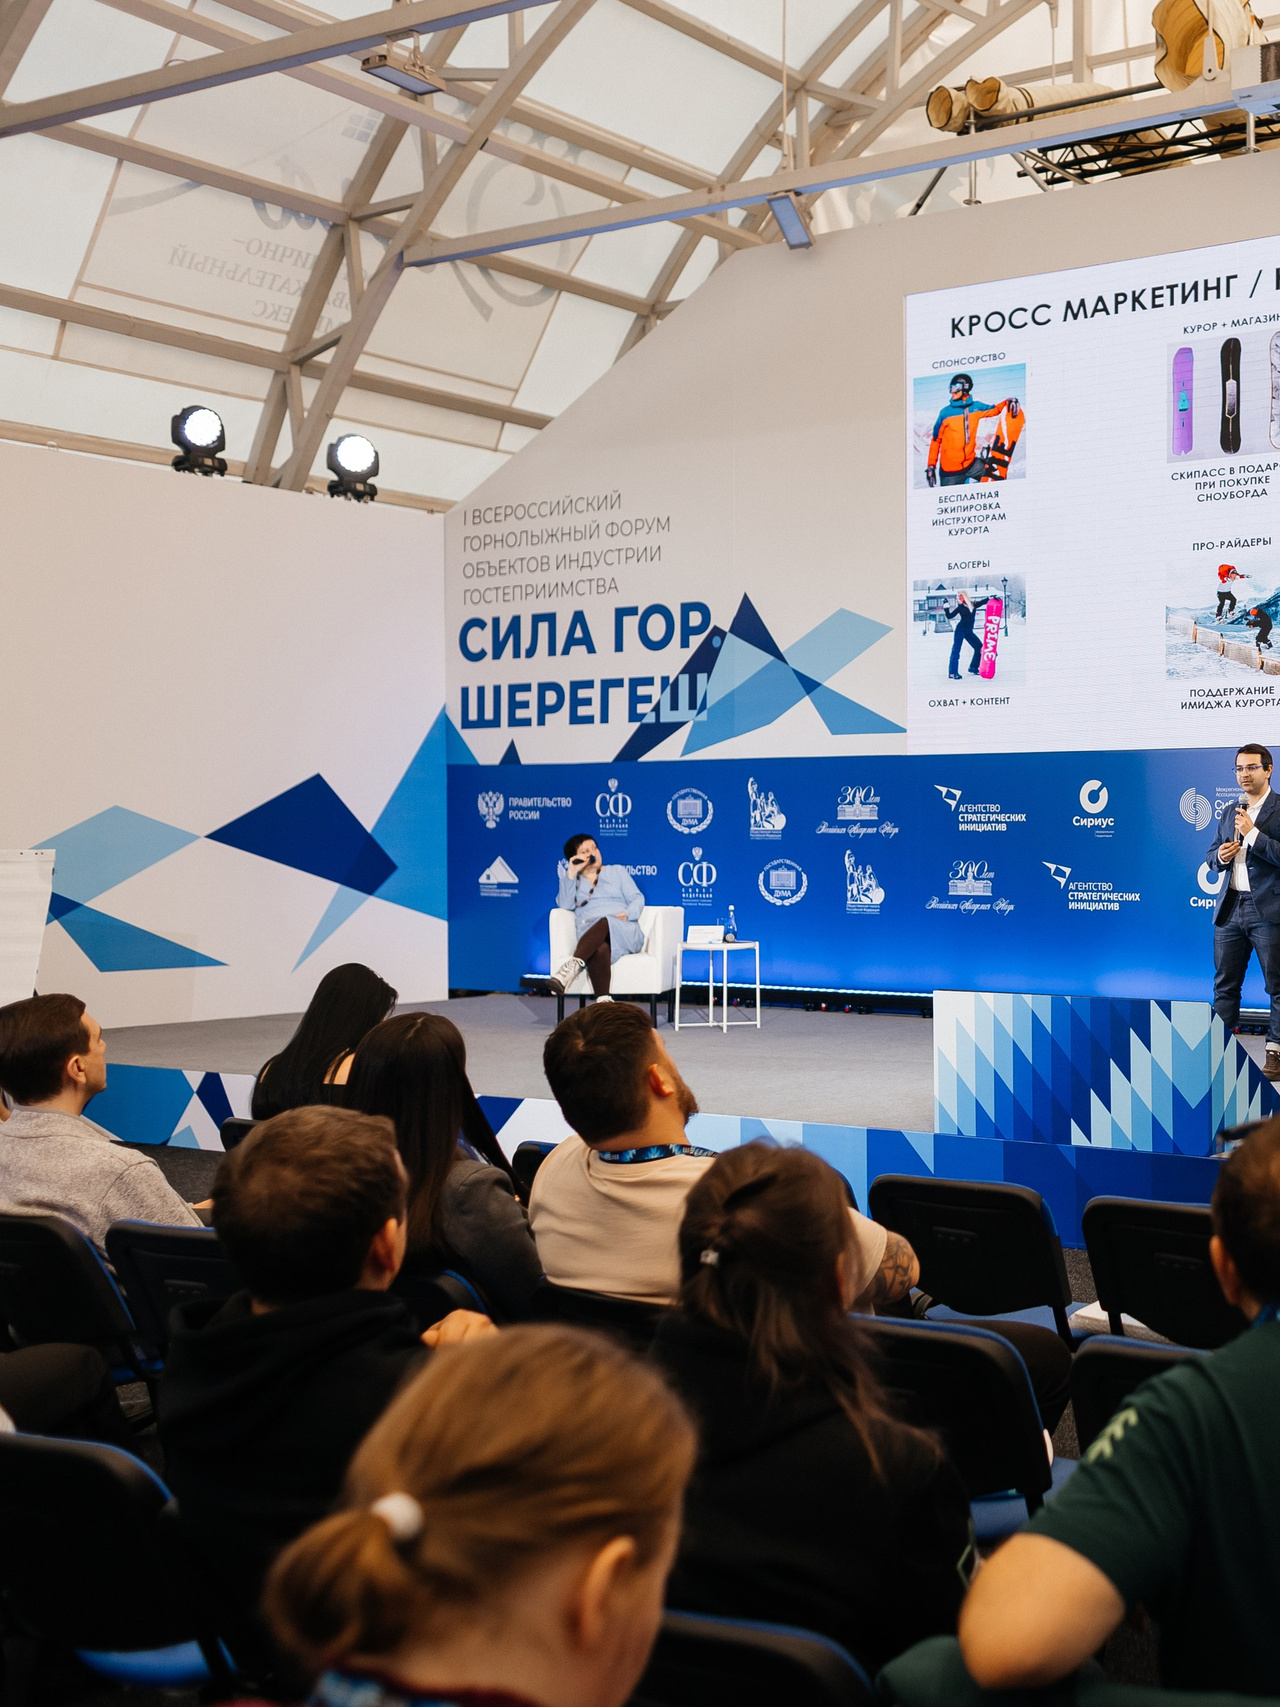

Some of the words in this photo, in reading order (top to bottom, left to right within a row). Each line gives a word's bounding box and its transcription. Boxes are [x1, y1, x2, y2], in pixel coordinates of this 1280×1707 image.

[951, 304, 1051, 338] КРОСС
[1062, 274, 1238, 322] МАРКЕТИНГ
[1249, 269, 1263, 298] /
[1183, 322, 1217, 334] КУРОР
[932, 352, 1006, 369] СПОНСОРСТВО
[1171, 467, 1226, 481] СКИПАСС
[1230, 467, 1235, 475] В
[1195, 481, 1216, 490] ПРИ
[1219, 475, 1270, 488] ПОКУПКЕ
[938, 491, 999, 504] БЕСПЛАТНАЯ
[1197, 488, 1268, 502] СНОУБОРДА
[471, 489, 622, 526] ВСЕРОССИЙСКИЙ
[937, 502, 1001, 515] ЭКИПИРОВКА
[932, 513, 1007, 526] ИНСТРУКТОРАМ
[463, 521, 601, 552] ГОРНОЛЫЖНЫЙ
[604, 515, 671, 539] ФОРУМ
[948, 525, 990, 536] КУРОРТА
[1192, 537, 1272, 551] ПРО-РАЙДЕРЫ
[462, 554, 551, 579] ОБЪЕКТОВ
[555, 545, 662, 572] ИНДУСТРИИ
[948, 560, 990, 571] БЛОГЕРЫ
[463, 577, 619, 605] ГОСТЕПРИИМСТВА
[458, 609, 597, 662] СИЛА
[613, 601, 711, 652] ГОР
[983, 615, 1000, 661] PRIME
[1190, 686, 1275, 697] ПОДДЕРЖАНИЕ
[460, 672, 708, 730] ШЕРЕГЕШ
[928, 698, 959, 708] ОХВАТ
[970, 697, 1010, 706] КОНТЕНТ
[1181, 700, 1232, 710] ИМИДЖА
[508, 797, 572, 807] ПРАВИТЕЛЬСТВО
[595, 792, 632, 818] СФ
[958, 804, 1001, 813] АГЕНТСТВО
[508, 811, 540, 820] РОССИИ
[681, 818, 698, 826] ДУМА
[958, 813, 1027, 822] СТРАТЕГИЧЕСКИХ
[1072, 816, 1115, 828] Сириус
[958, 823, 1007, 832] ИНИЦИАТИВ
[678, 862, 717, 887] СФ
[1068, 882, 1113, 891] АГЕНТСТВО
[774, 890, 791, 898] ДУМА
[1068, 892, 1141, 901] СТРАТЕГИЧЕСКИХ
[1068, 901, 1120, 911] ИНИЦИАТИВ
